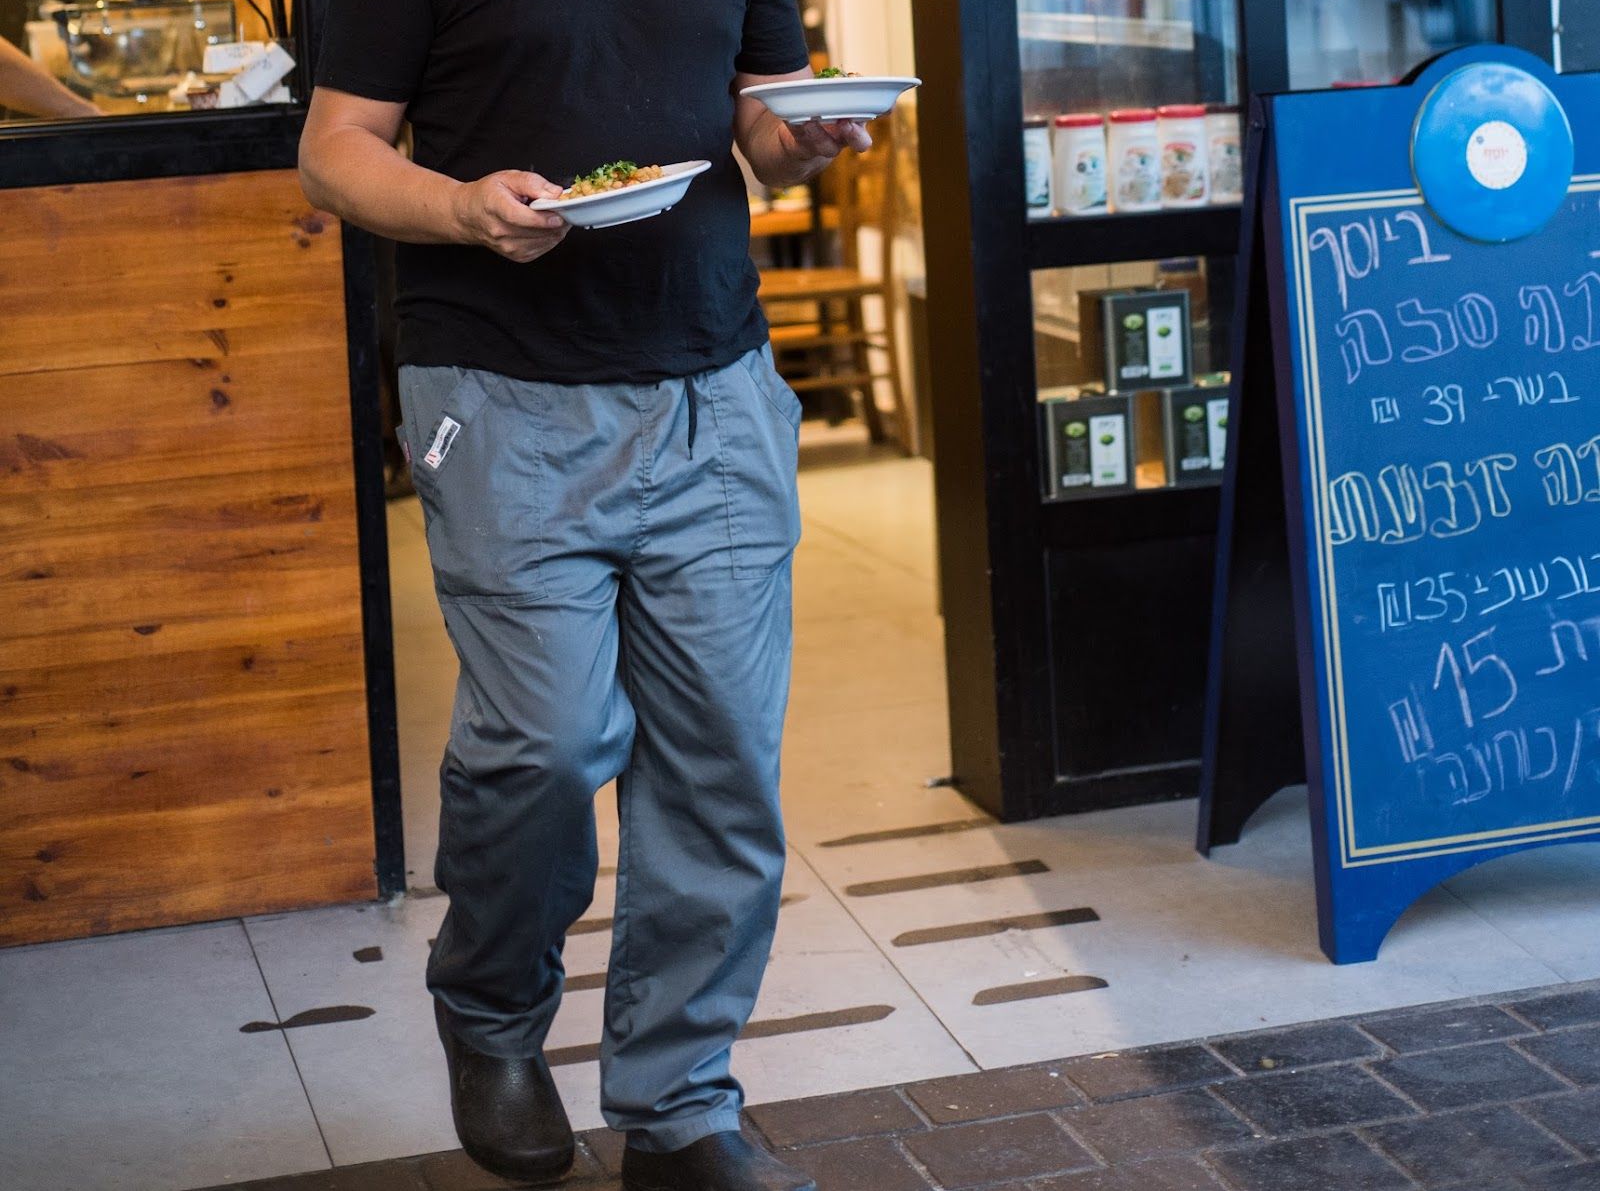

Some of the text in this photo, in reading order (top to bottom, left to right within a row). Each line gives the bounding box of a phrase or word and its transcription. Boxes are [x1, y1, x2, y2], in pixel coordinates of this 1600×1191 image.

[1309, 210, 1451, 311] ביוסף
[1422, 383, 1466, 426] 39
[1432, 625, 1518, 729] 15
